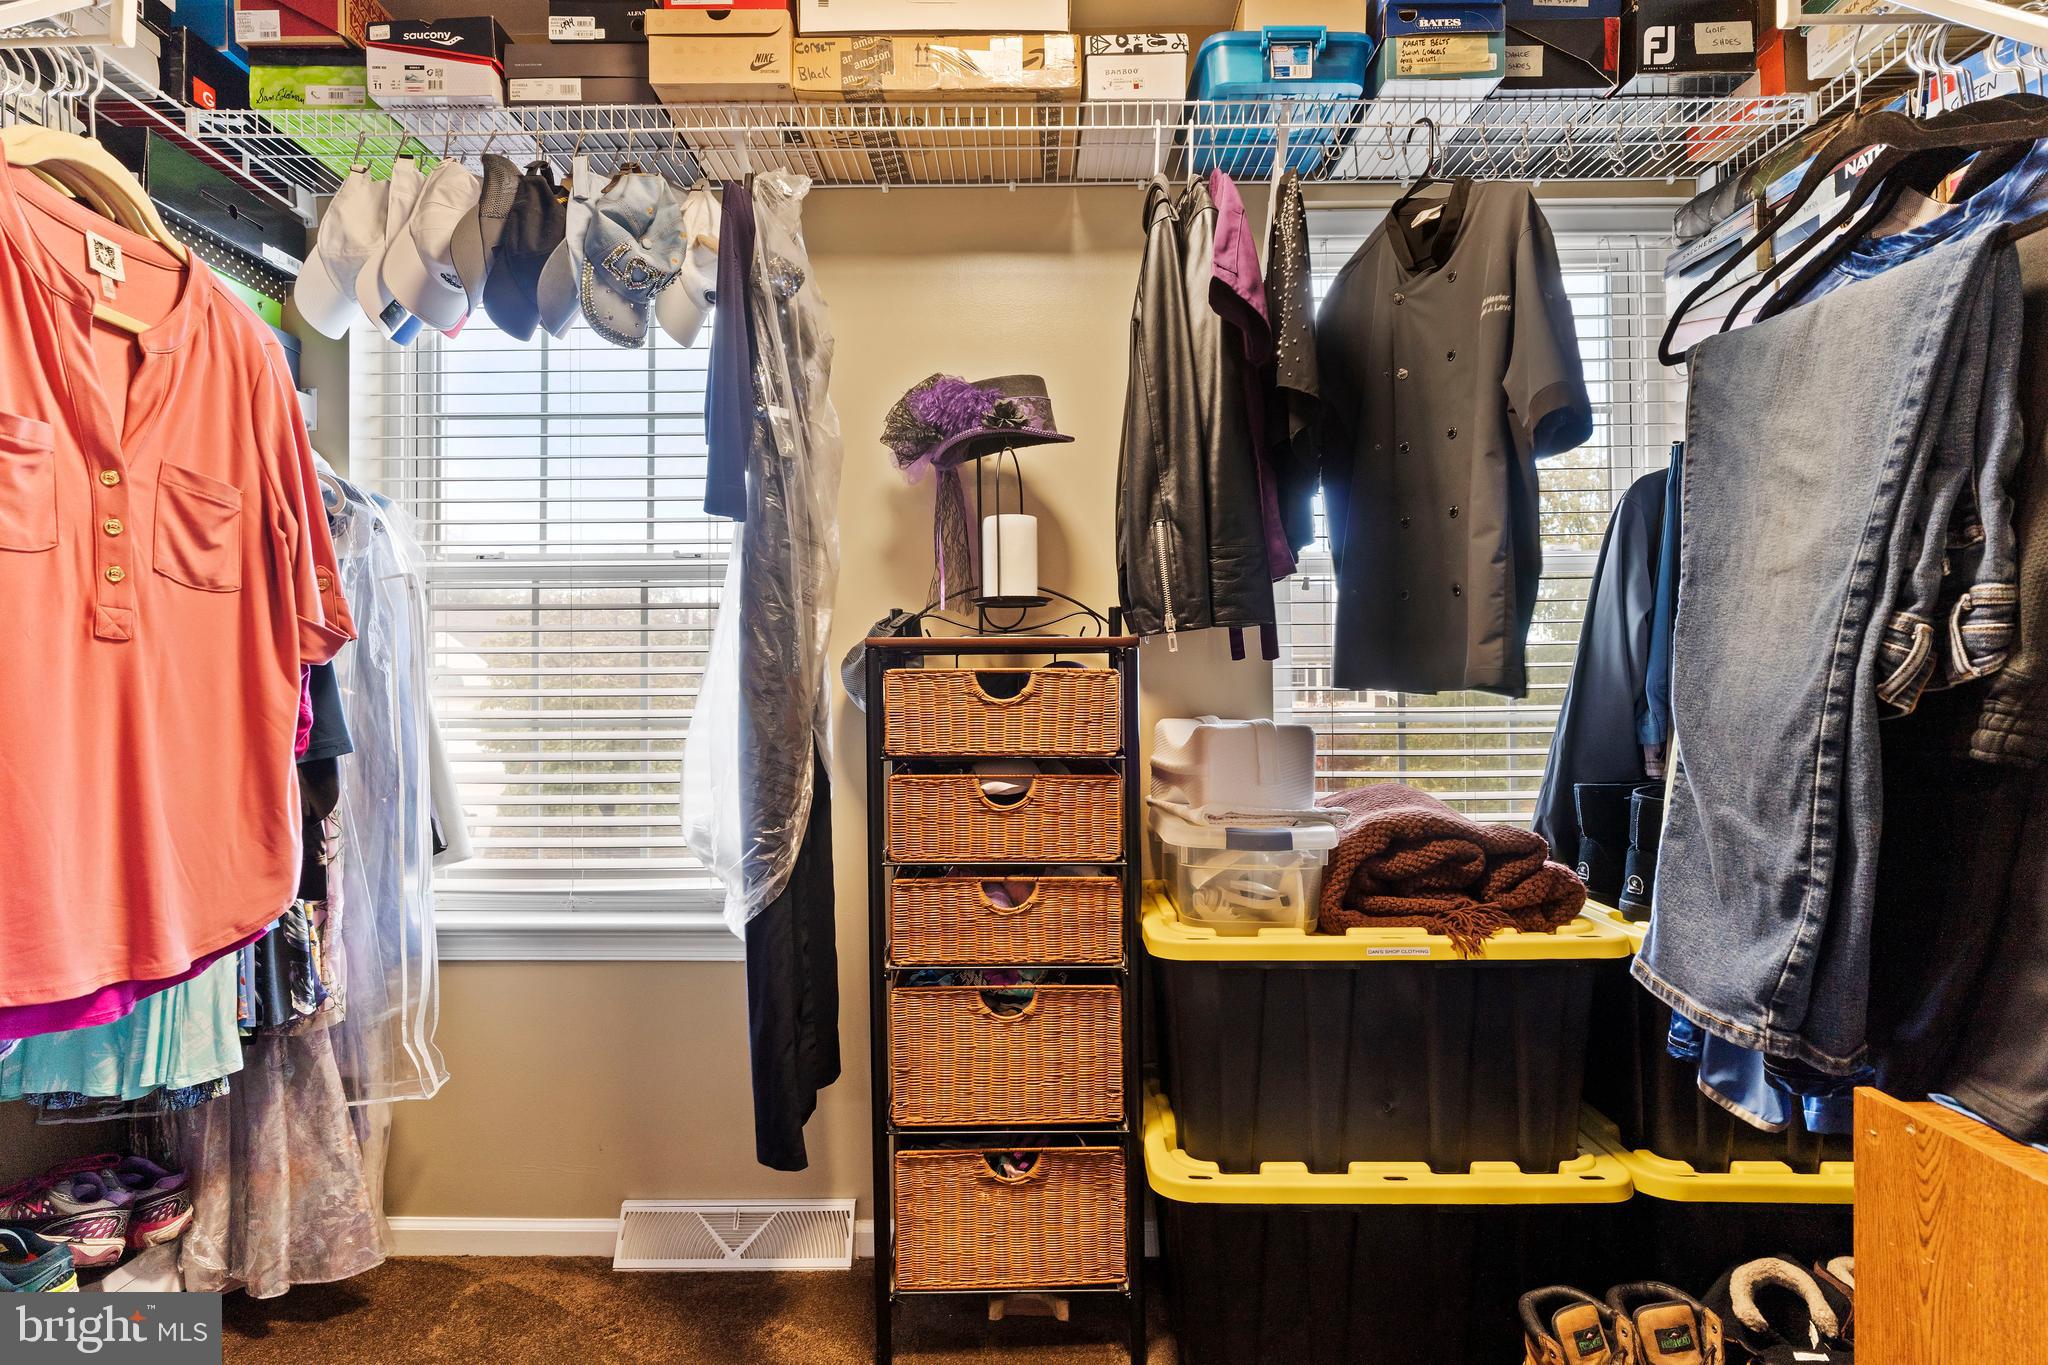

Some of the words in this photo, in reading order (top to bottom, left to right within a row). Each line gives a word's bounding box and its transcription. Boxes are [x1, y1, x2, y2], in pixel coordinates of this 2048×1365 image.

[1419, 18, 1461, 27] BATES
[402, 31, 451, 40] saucony
[1402, 39, 1426, 48] KARATE
[1430, 38, 1451, 46] BELTS
[1712, 37, 1741, 46] SHOES
[754, 53, 775, 63] NIKE
[1505, 50, 1530, 58] DANCE
[854, 51, 891, 70] amazon
[1401, 65, 1412, 73] CUP
[1507, 63, 1531, 71] SHOES
[798, 65, 832, 81] Black
[1682, 235, 1718, 260] SKECHERS
